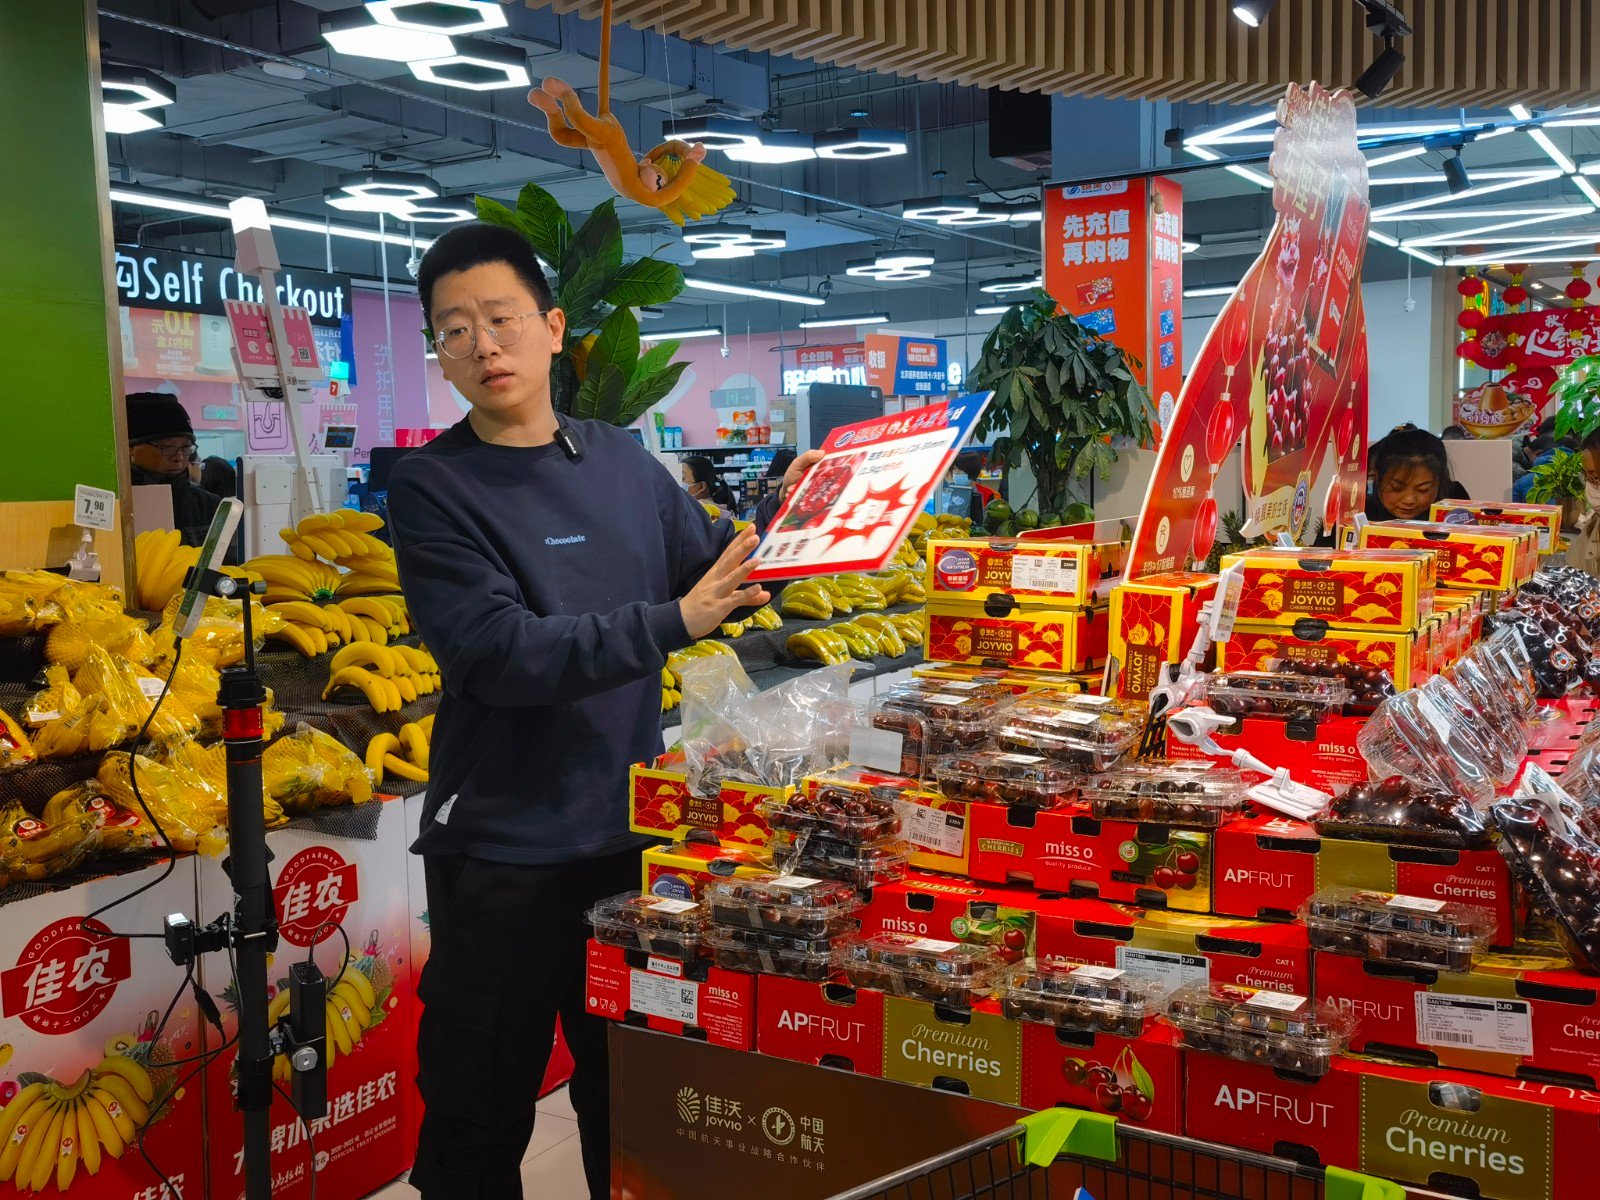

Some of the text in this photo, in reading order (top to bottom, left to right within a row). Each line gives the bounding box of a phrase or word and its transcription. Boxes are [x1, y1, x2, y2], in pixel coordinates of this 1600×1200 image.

[1062, 209, 1130, 239] 先充值
[1062, 236, 1130, 266] 再购物
[143, 256, 203, 305] Self
[84, 499, 105, 515] 7.90
[1290, 595, 1336, 606] JOYVIO
[976, 640, 1014, 651] JOYVIO
[1131, 651, 1143, 693] JOYVIO
[1319, 742, 1345, 754] miss
[687, 811, 719, 823] JOYVIO
[981, 843, 1020, 855] CHERRIES
[1045, 841, 1080, 857] miss
[1045, 860, 1092, 871] quality produce
[1224, 868, 1294, 889] APFRUT
[1446, 874, 1496, 887] Premium
[281, 871, 346, 925] 佳农
[1433, 882, 1497, 900] Cherries
[882, 917, 916, 933] miss
[1181, 957, 1195, 965] 2JD
[1275, 958, 1288, 966] CAT
[23, 945, 113, 1010] 佳农
[1248, 966, 1294, 980] Premium
[708, 986, 731, 998] miss
[1235, 974, 1295, 993] Cherries
[1497, 1002, 1513, 1011] 2JD
[777, 1009, 866, 1043] APFRUT
[911, 1023, 992, 1051] Premium
[901, 1038, 1001, 1077] Cherries
[704, 1094, 742, 1119] 佳沃
[1214, 1085, 1334, 1128] APFRUT
[706, 1116, 742, 1132] JOYVIO
[800, 1115, 824, 1135] 中国
[1399, 1109, 1511, 1144] Premium
[676, 1127, 826, 1172] 中国航天事业战略合作伙伴
[800, 1133, 825, 1154] 航天
[1385, 1126, 1525, 1175] Cherries
